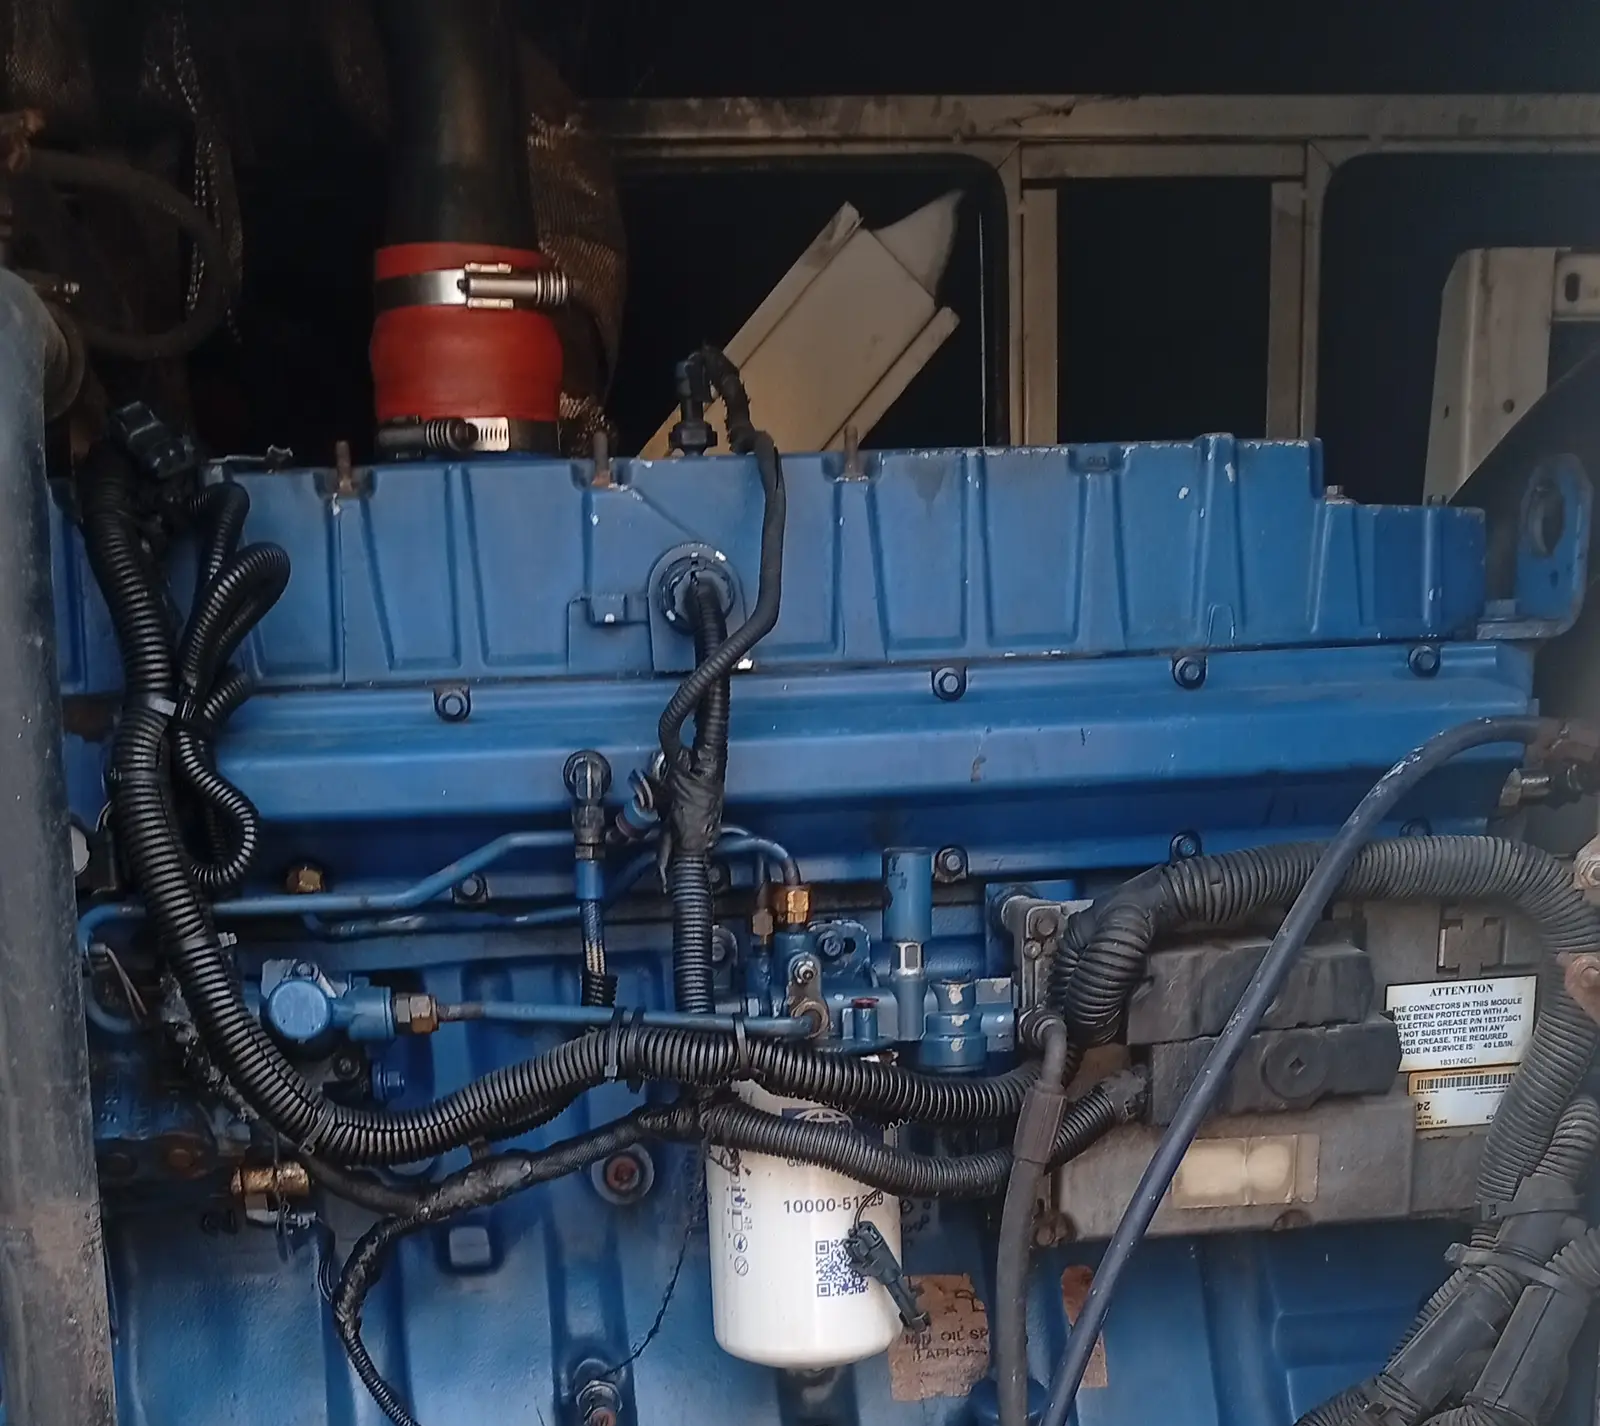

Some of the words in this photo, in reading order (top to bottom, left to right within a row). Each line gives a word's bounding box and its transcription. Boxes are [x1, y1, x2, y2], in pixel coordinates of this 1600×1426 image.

[1430, 984, 1494, 997] ATTENTION
[1392, 1005, 1406, 1014] THE
[1408, 1002, 1460, 1012] CONNECTORS
[1490, 997, 1522, 1006] MODULE
[1413, 1012, 1434, 1020] BEEN
[1435, 1010, 1481, 1019] PROTECTED
[1398, 1021, 1435, 1030] ELECTRIC
[1437, 1018, 1468, 1027] GREASE
[1421, 1027, 1467, 1037] SUBSTITUTE
[1489, 1024, 1505, 1032] ANY
[1400, 1039, 1416, 1047] HER
[1418, 1037, 1451, 1046] GREASE.
[1469, 1032, 1508, 1041] REQUIRED
[1401, 1047, 1420, 1055] RQUE
[1432, 1044, 1464, 1053] SERVICE
[969, 1327, 988, 1340] SP
